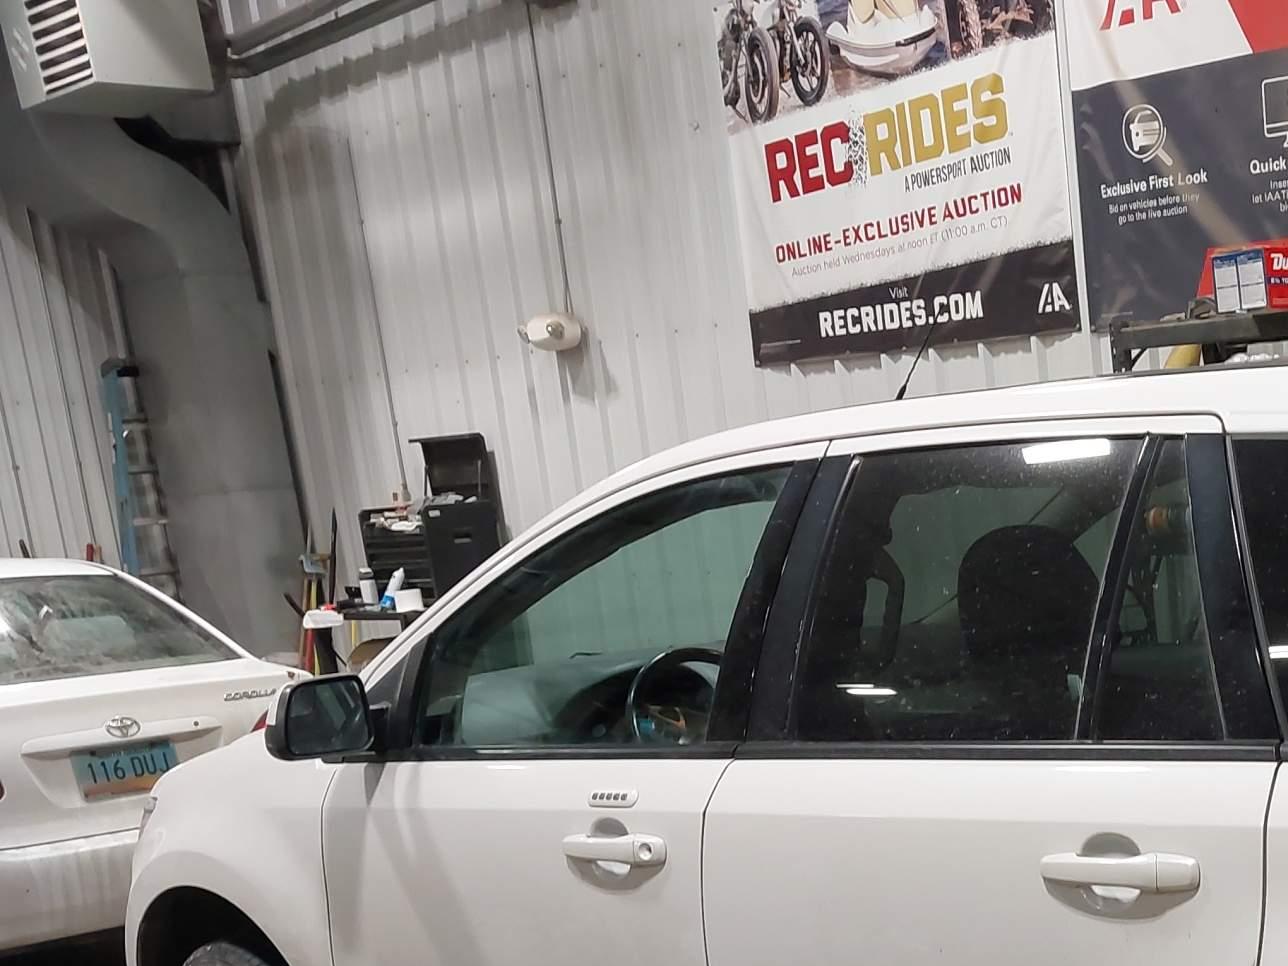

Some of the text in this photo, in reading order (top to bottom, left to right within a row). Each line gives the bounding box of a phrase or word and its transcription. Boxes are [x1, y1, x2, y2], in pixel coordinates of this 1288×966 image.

[765, 72, 1009, 203] REC RIDES
[904, 147, 1011, 192] A POWERSPORT AUCTION
[1250, 155, 1287, 175] Quick
[1100, 168, 1208, 199] Exclusive First Look
[1252, 193, 1263, 204] let
[1264, 190, 1280, 202] IAA
[1109, 192, 1200, 214] Bid on vehicles before they
[1118, 204, 1188, 226] go to the live auction
[776, 183, 1023, 263] ONLINE-EXCLUSIVE AUCTION
[792, 263, 821, 277] Auction
[823, 258, 840, 270] held
[842, 245, 895, 264] Wednesdays
[908, 238, 927, 249] noon
[990, 215, 1008, 229] CT)
[888, 287, 909, 300] Visit
[818, 290, 984, 338] RECRIDES.COM
[88, 751, 169, 784] 116 DUJ
